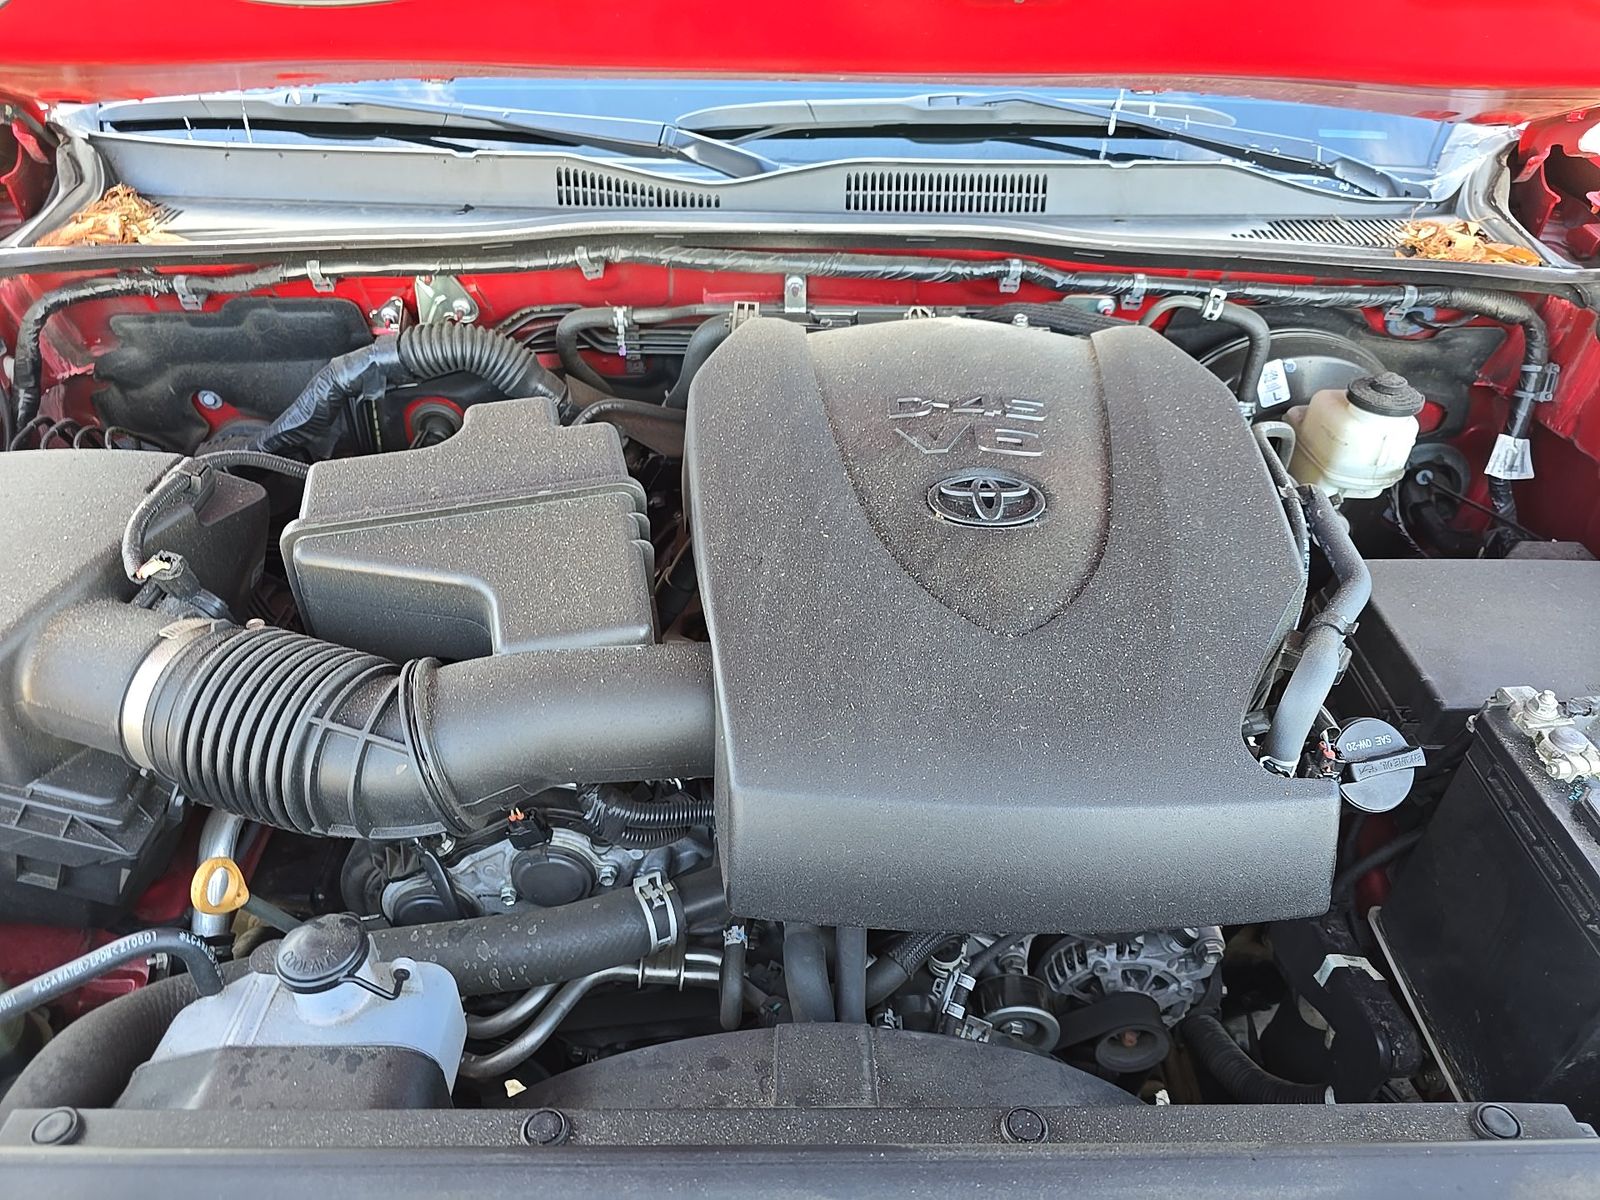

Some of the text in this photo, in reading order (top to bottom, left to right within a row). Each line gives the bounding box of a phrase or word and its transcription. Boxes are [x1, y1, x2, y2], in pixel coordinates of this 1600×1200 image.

[888, 396, 1048, 422] D-4S
[894, 422, 1046, 457] V6
[1346, 734, 1391, 752] SAE 0W-20
